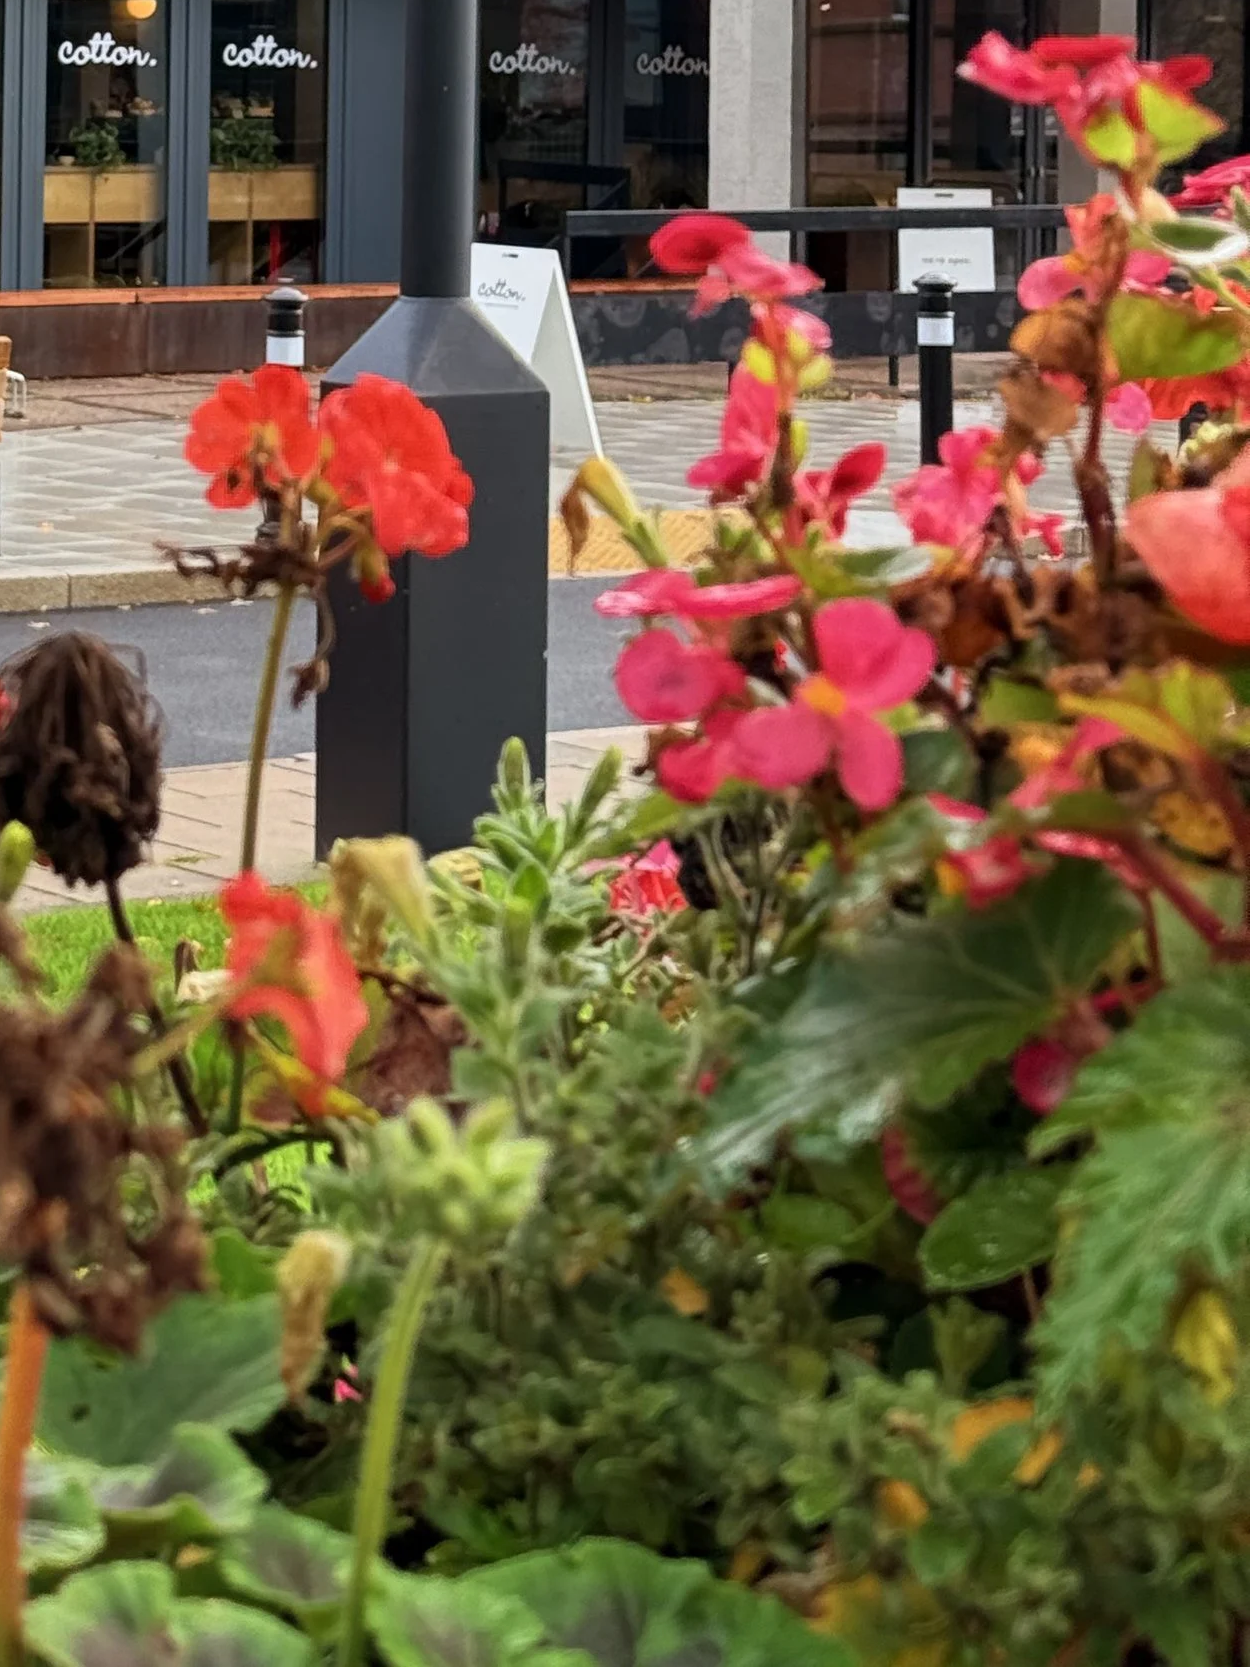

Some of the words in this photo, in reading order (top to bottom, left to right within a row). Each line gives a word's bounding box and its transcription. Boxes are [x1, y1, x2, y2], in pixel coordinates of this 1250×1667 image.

[57, 32, 158, 67] cotton.
[222, 35, 319, 69] cotton.
[489, 43, 577, 75] cotton.
[477, 278, 526, 302] cotton.
